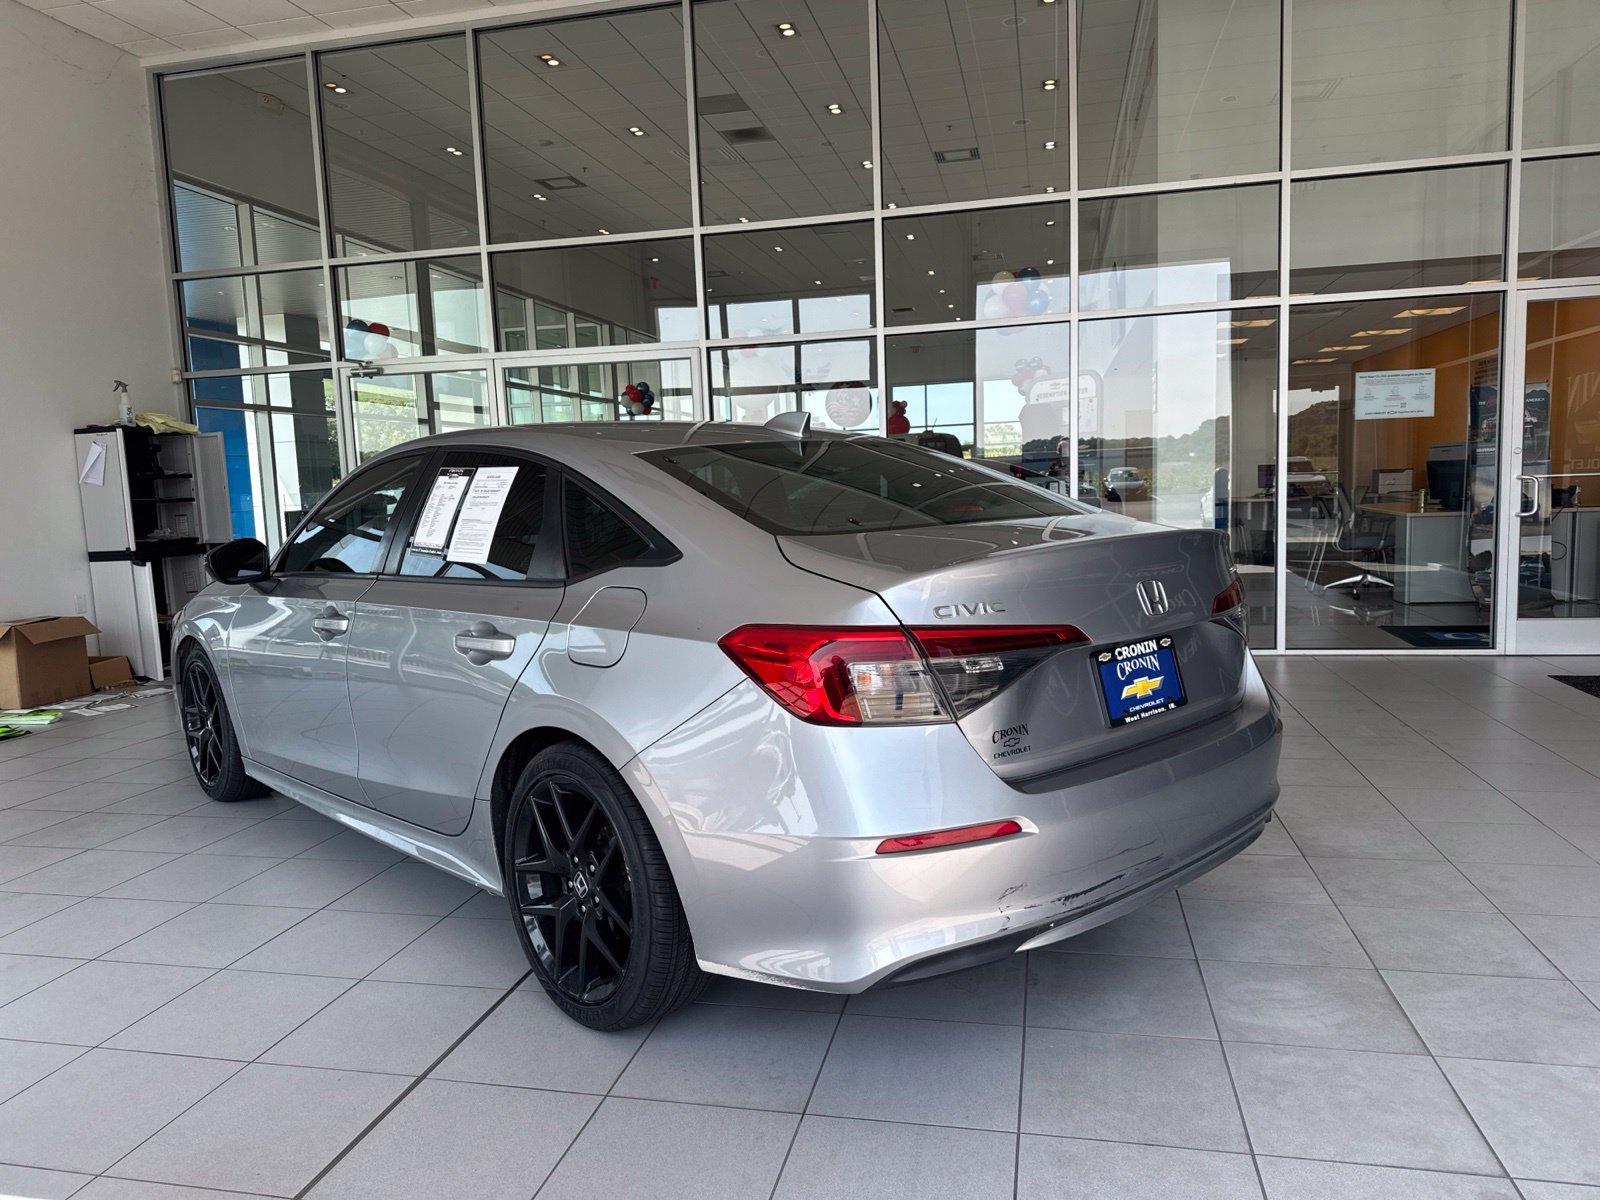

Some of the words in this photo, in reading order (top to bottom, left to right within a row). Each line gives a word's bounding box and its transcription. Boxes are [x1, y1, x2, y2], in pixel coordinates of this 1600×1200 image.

[933, 601, 1006, 619] CIVIC
[1114, 639, 1157, 660] CRONIN
[1116, 654, 1160, 680] CRONIN
[1129, 698, 1164, 712] CHEVROLET
[1124, 714, 1140, 723] West
[992, 723, 1029, 744] CRONIN
[993, 745, 1031, 759] CHEVROLET
